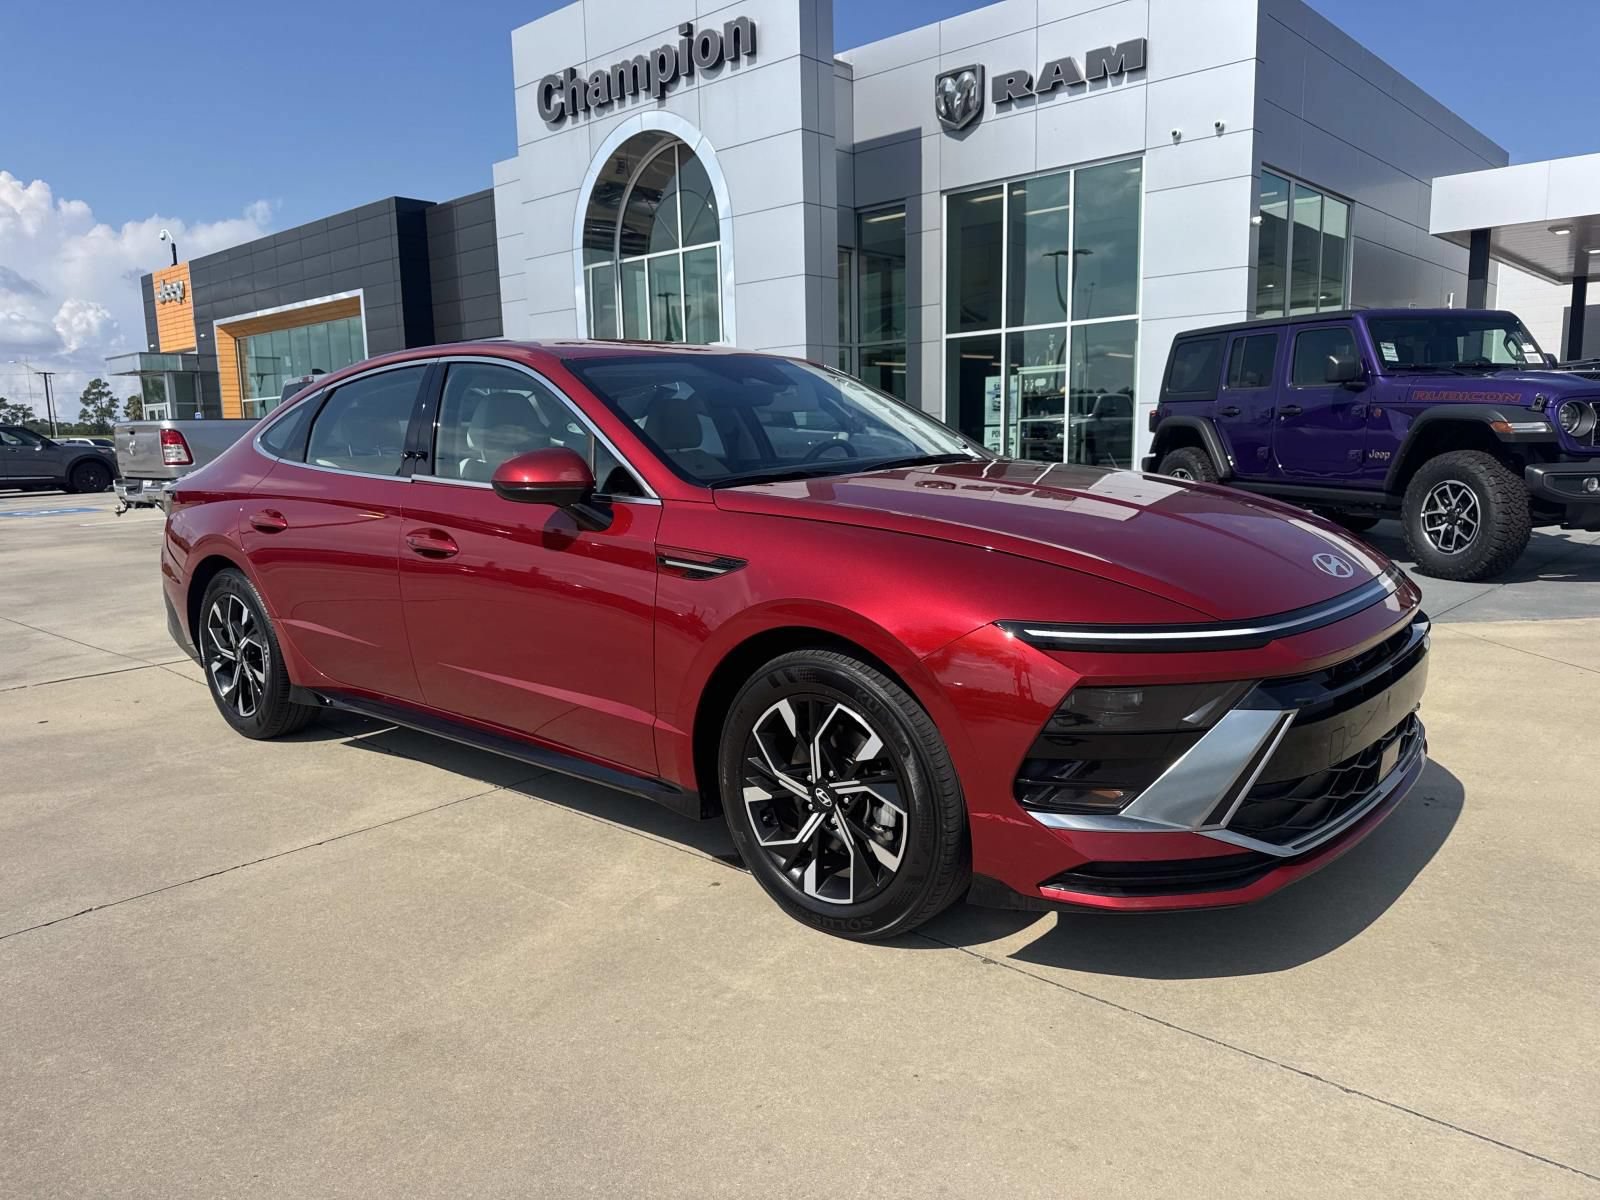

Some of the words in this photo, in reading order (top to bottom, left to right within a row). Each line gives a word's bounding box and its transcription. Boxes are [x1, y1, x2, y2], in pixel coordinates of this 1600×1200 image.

[537, 16, 757, 122] Champion
[992, 37, 1147, 104] RAM
[157, 280, 185, 304] Jeep
[1413, 390, 1522, 404] RUBICON
[1368, 449, 1391, 461] Jeep
